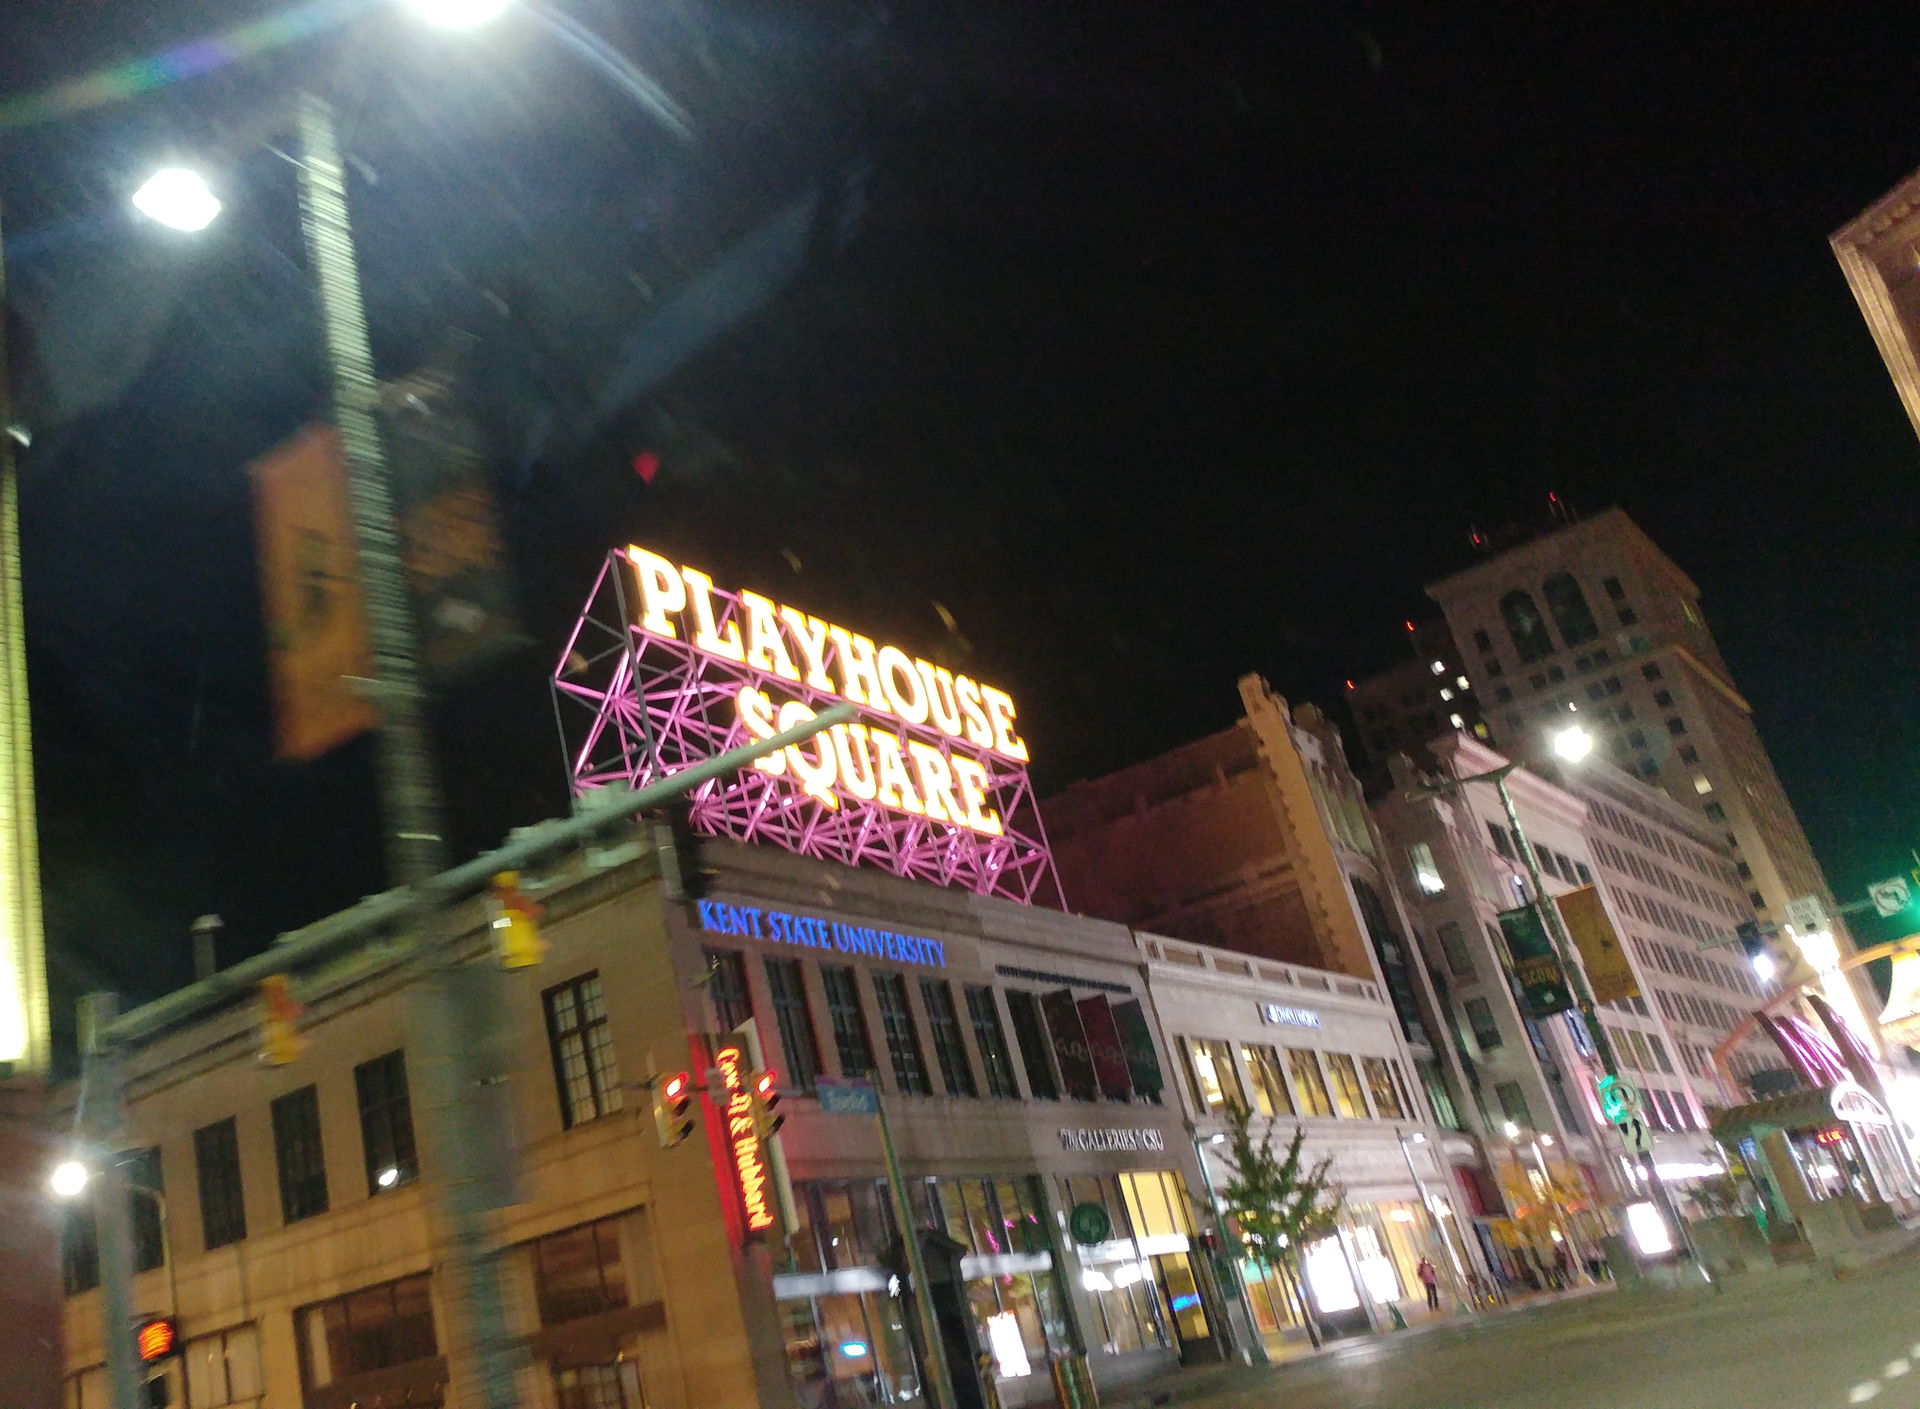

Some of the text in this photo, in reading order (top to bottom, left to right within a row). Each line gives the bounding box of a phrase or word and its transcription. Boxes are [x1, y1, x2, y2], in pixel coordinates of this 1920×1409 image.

[627, 543, 1030, 763] PLAYHOUSE
[734, 685, 1004, 836] SQUARE
[697, 900, 946, 968] KENT STATE UNIVERSITY
[729, 1116, 754, 1137] &
[1078, 1128, 1137, 1151] GALLERIES
[1142, 1128, 1164, 1151] CSU
